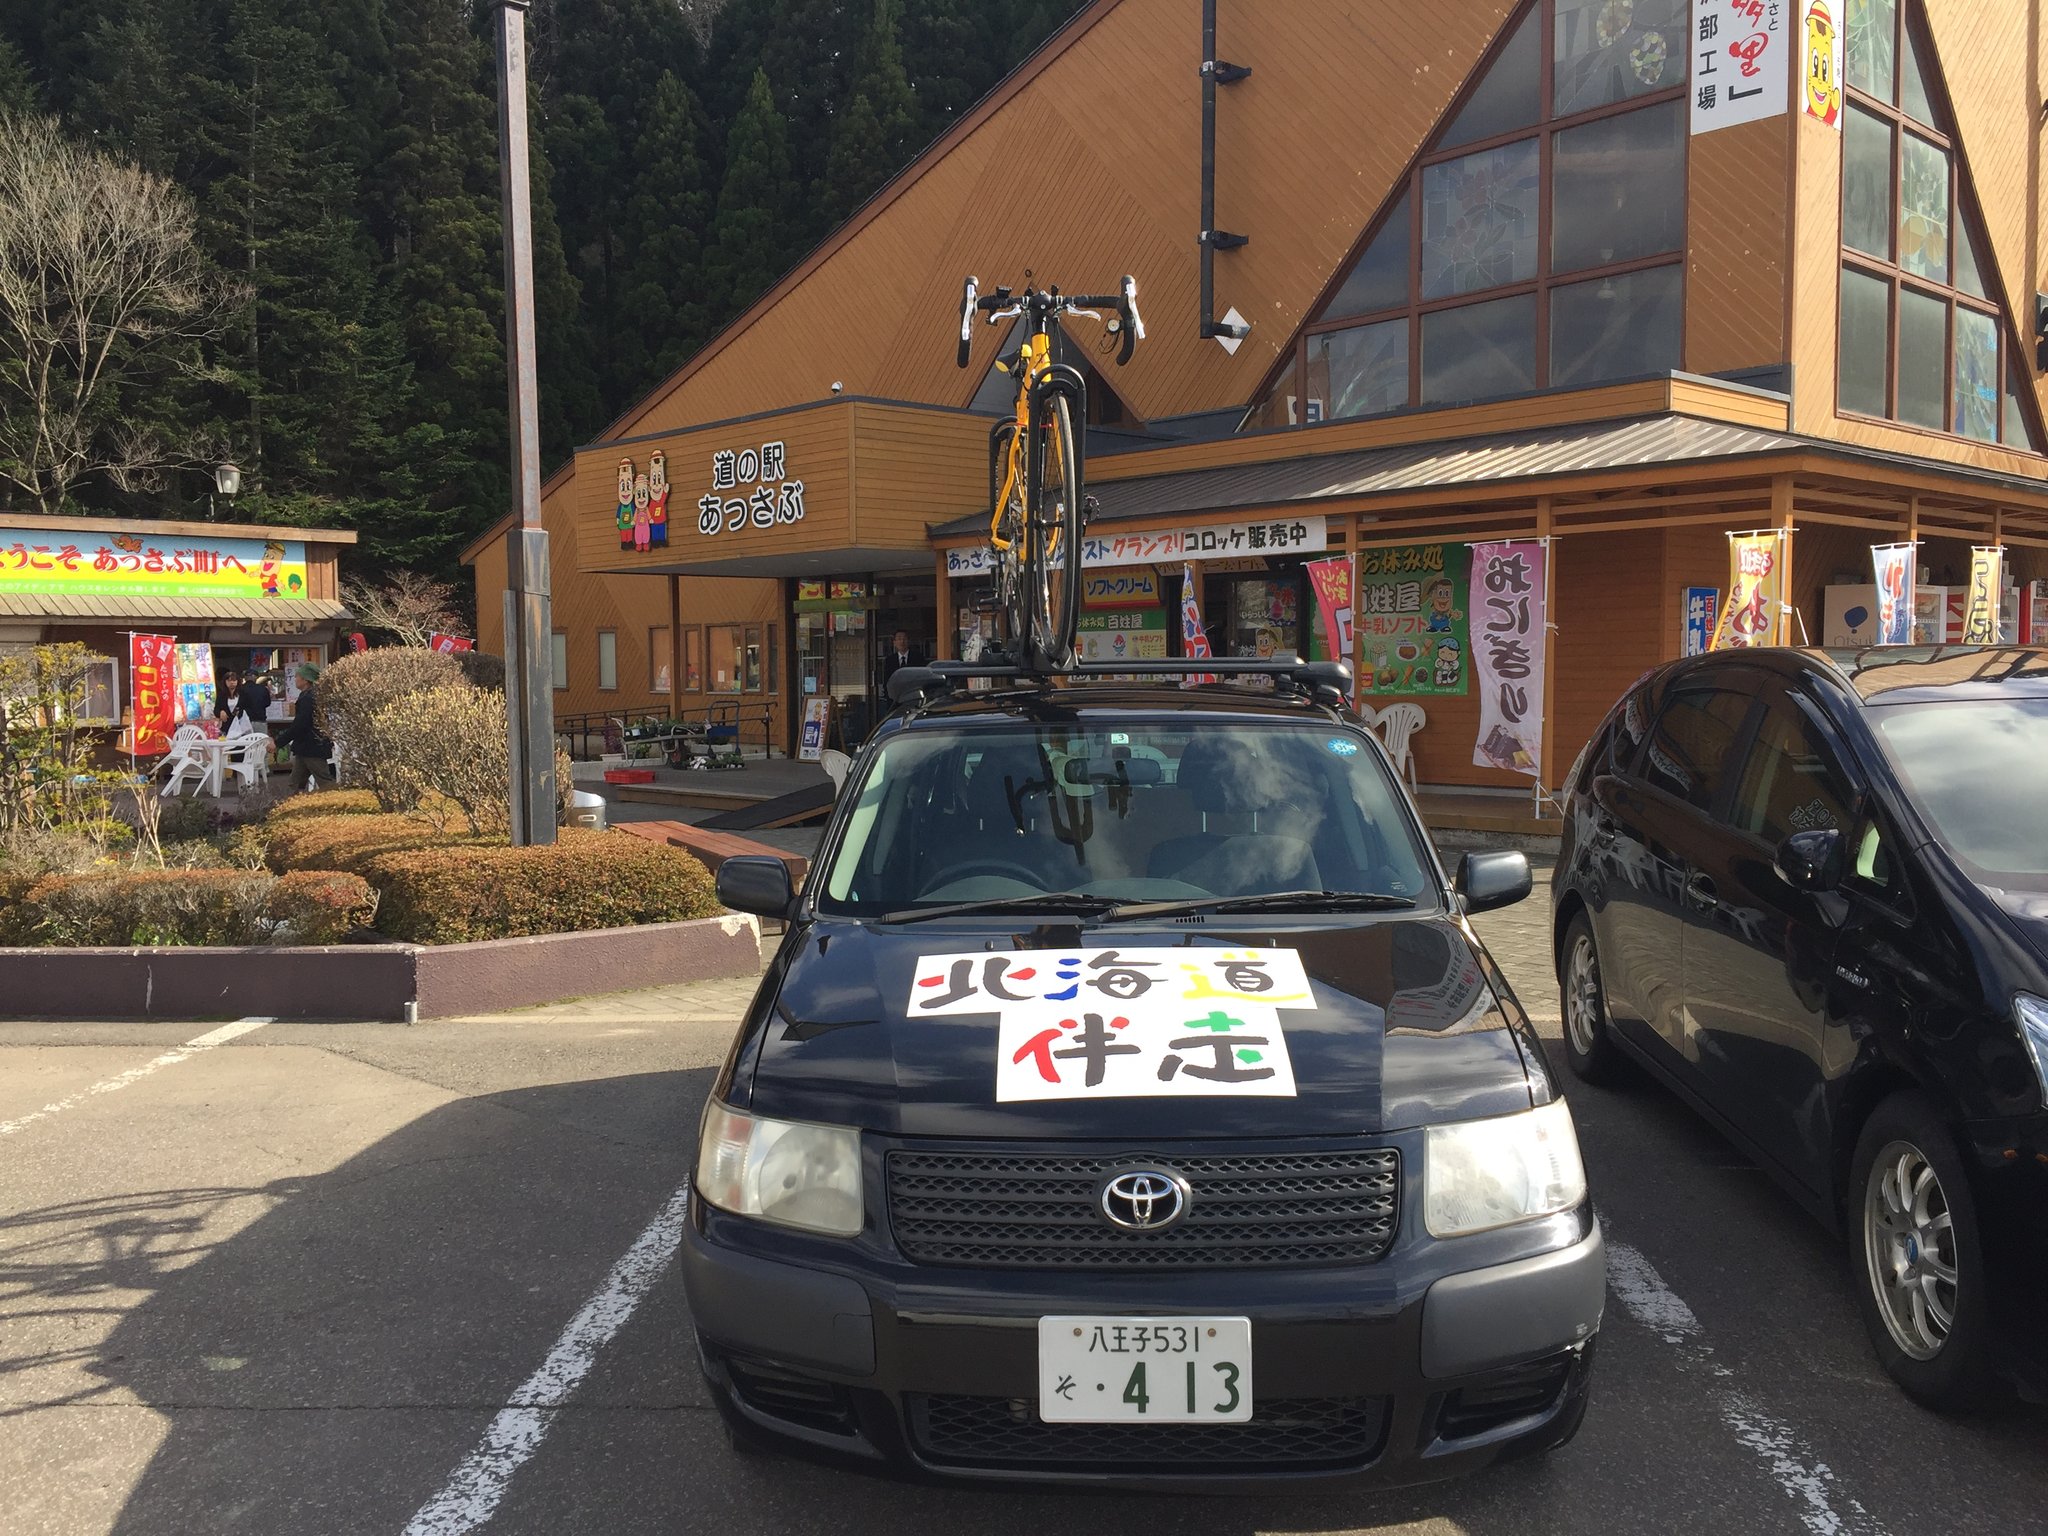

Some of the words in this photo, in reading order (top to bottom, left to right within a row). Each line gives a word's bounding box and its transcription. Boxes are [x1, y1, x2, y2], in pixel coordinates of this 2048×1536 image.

[1767, 0, 1780, 31] さと
[1698, 0, 1718, 110] 部工場
[714, 443, 785, 489] 道の駅
[699, 482, 803, 534] あっさぶ
[0, 543, 82, 571] うこそ
[93, 546, 248, 574] あっさぶ町へ
[1087, 576, 1153, 597] ソフトクリーム
[257, 619, 307, 634] たいこ山
[1107, 613, 1143, 630] 百姓屋
[1362, 615, 1427, 635] 牛乳ソフト
[137, 665, 160, 745] コロッケ
[918, 951, 1309, 1009] 北海道
[1012, 1011, 1276, 1087] 伴走
